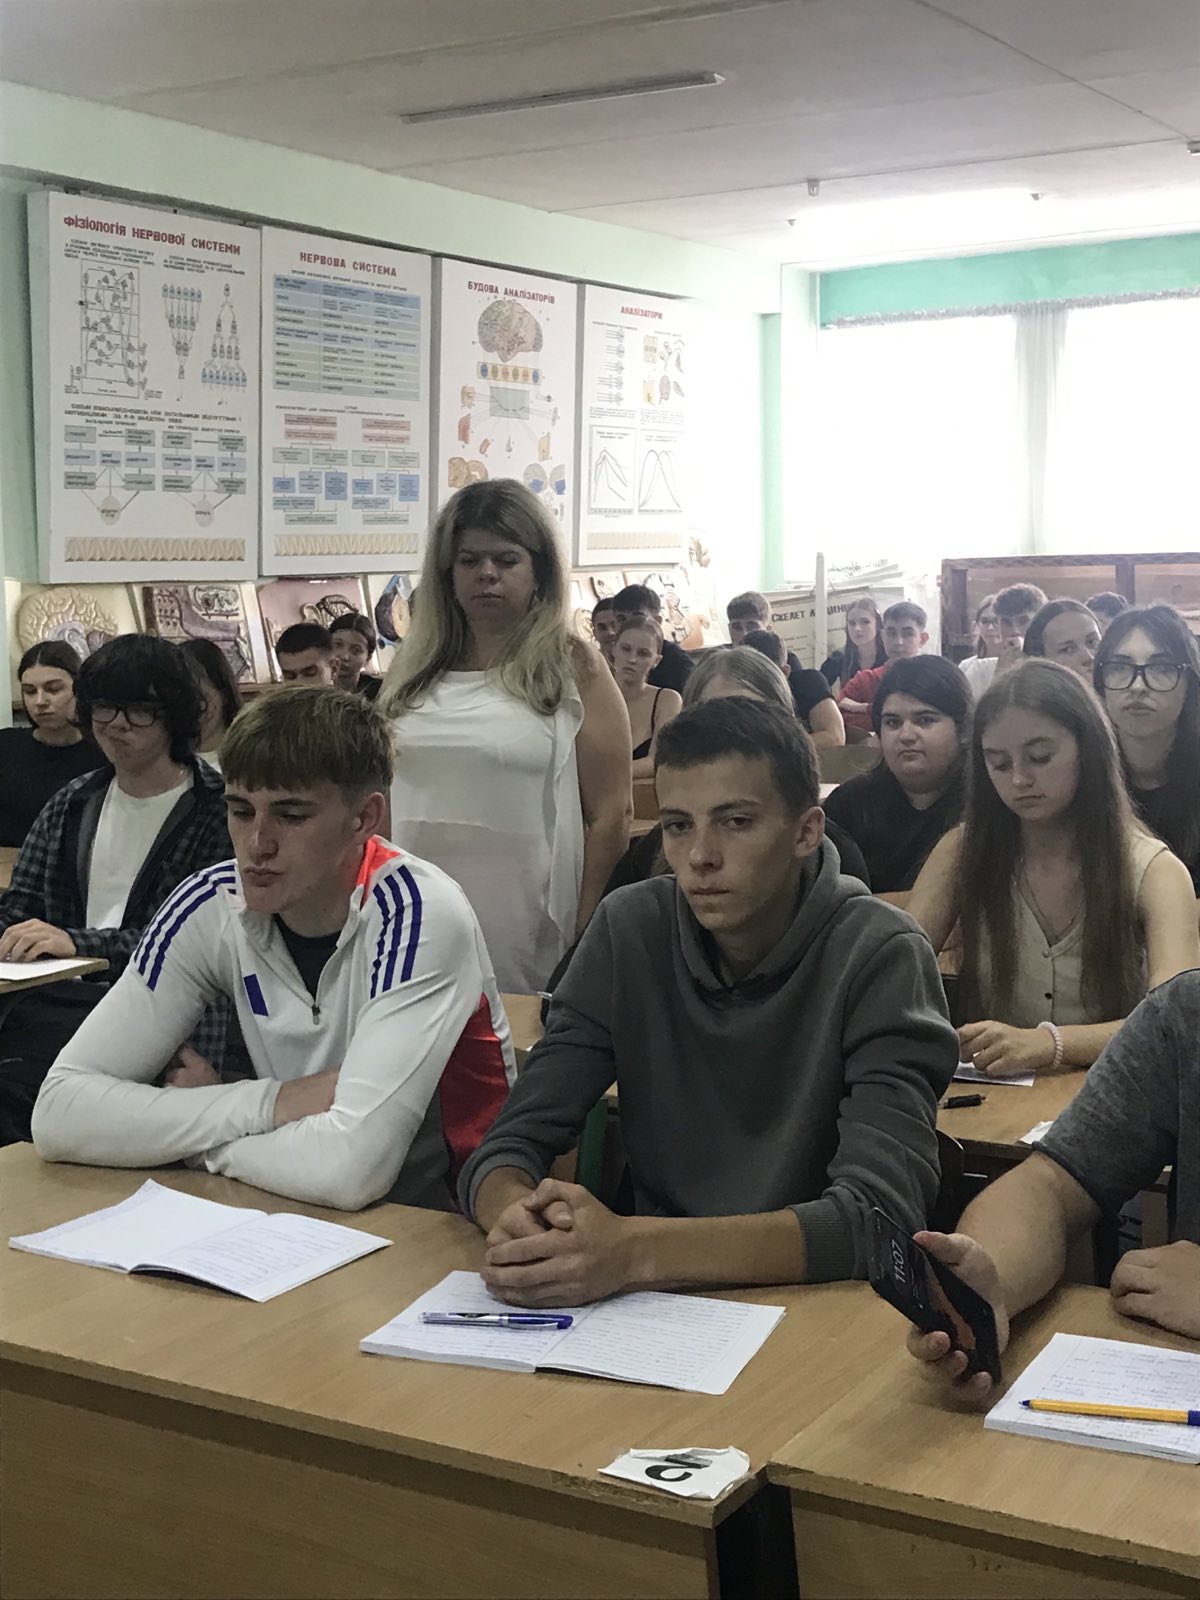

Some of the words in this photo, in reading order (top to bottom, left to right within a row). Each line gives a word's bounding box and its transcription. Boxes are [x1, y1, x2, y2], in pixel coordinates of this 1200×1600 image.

[63, 215, 126, 236] ФІЗІОЛОГІЯ
[132, 227, 185, 246] НЕРВОВОЇ
[191, 238, 241, 255] СИСТЕМИ
[300, 251, 346, 269] НЕРВОВА
[352, 261, 397, 277] СИСТЕМА
[467, 280, 500, 295] БУДОВА
[503, 287, 556, 304] АНАЛІЗАТОРІВ
[620, 305, 663, 320] АНАЛІЗАТОРИ
[771, 610, 805, 622] СКЕЛЕТ
